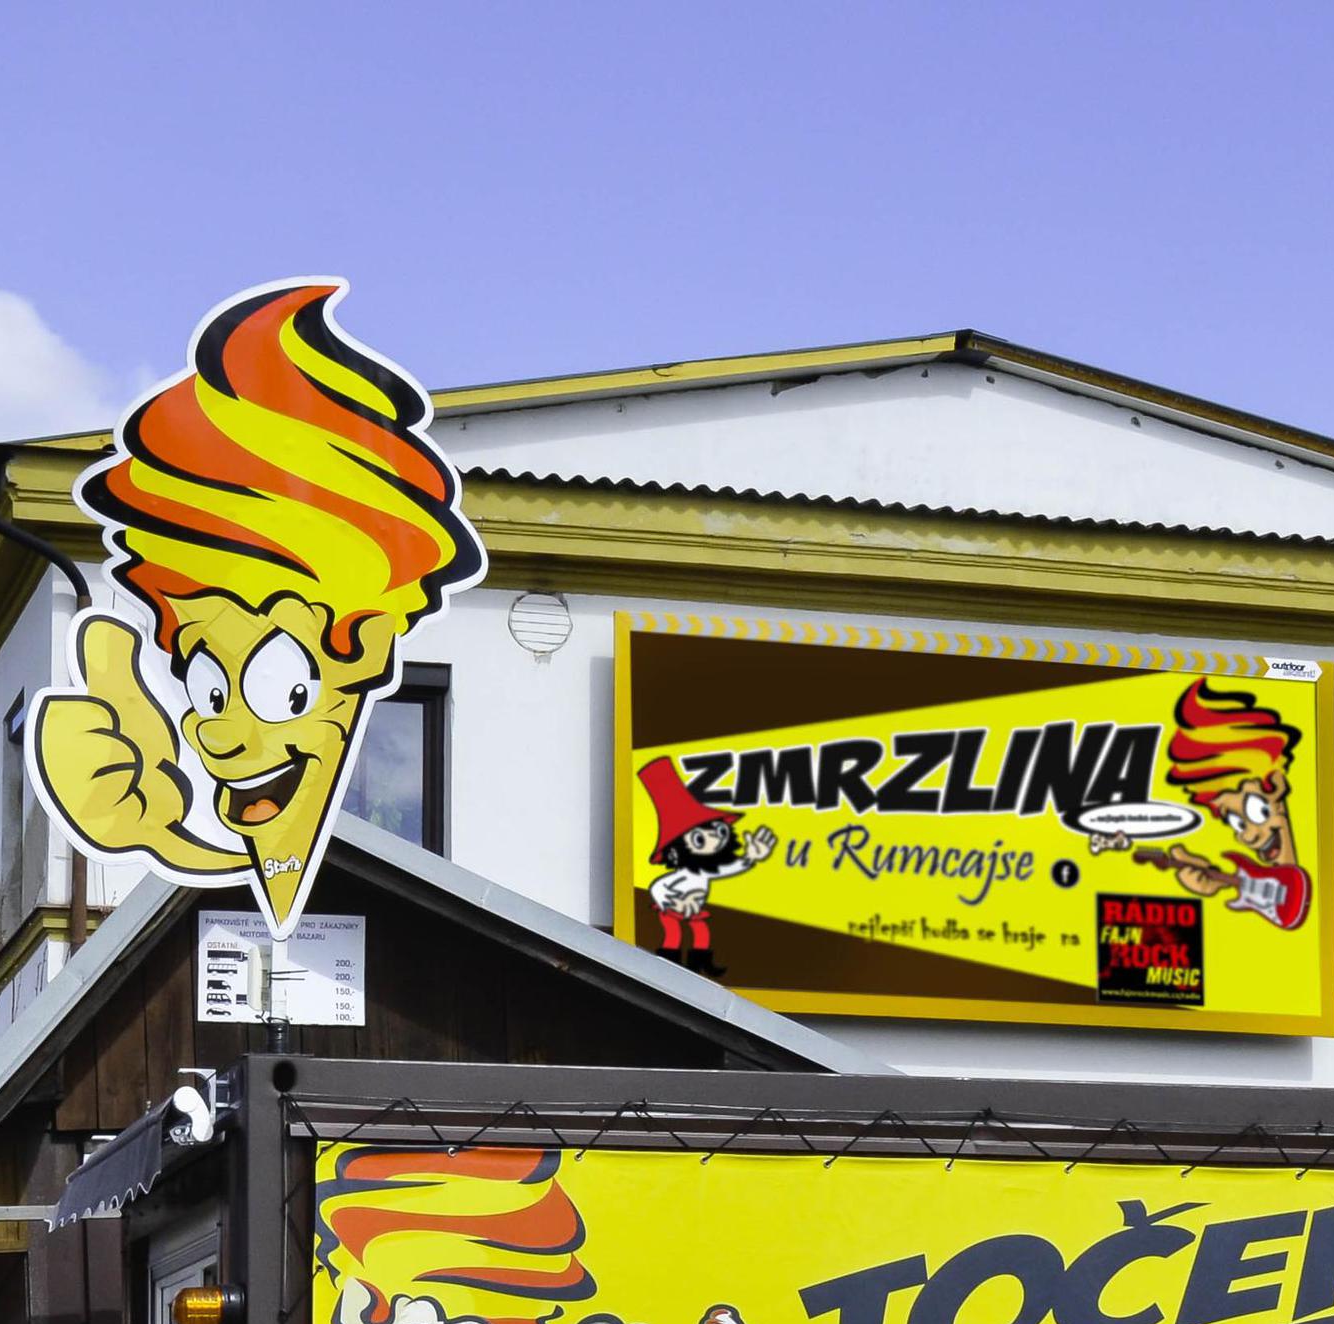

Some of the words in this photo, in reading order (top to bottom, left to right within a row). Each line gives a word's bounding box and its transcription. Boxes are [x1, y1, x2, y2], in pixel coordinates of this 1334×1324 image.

[681, 721, 1163, 818] ZMRZLINA
[786, 838, 812, 868] u
[827, 824, 1035, 906] Rumcajse
[296, 932, 326, 941] BAZARU
[921, 917, 970, 940] hudba
[977, 928, 996, 941] se
[1002, 921, 1046, 950] hraje
[1060, 932, 1081, 946] na
[1100, 925, 1143, 945] FAJN
[1109, 944, 1190, 969] ROCK
[1146, 966, 1201, 987] MUSIC
